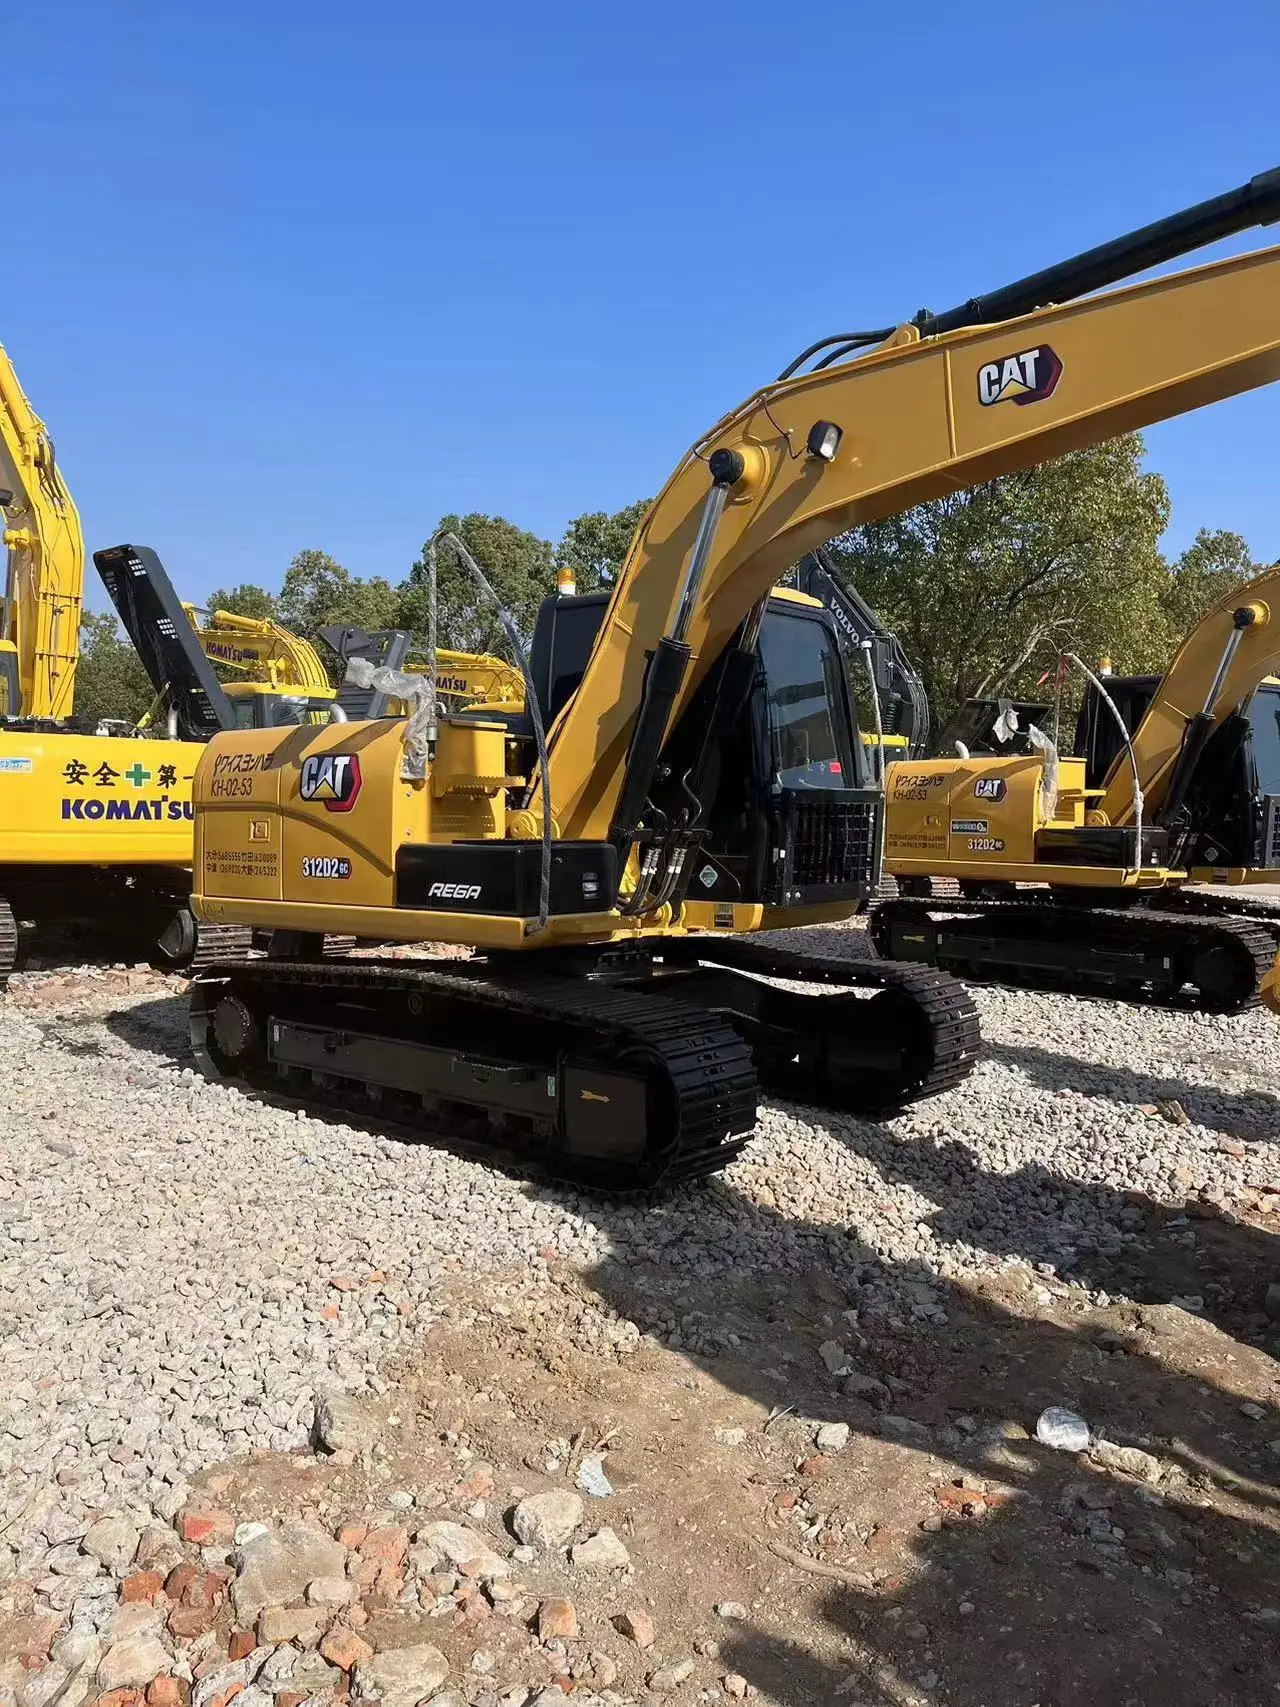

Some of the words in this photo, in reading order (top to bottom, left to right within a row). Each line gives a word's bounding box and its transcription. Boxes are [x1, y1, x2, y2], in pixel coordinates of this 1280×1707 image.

[979, 350, 1040, 404] CAT
[830, 596, 860, 644] VOLVO
[206, 640, 243, 662] KOMATSU
[62, 759, 121, 787] 安全
[301, 756, 351, 799] CAT
[211, 777, 253, 797] KH-02-53
[976, 779, 1001, 798] CAT
[302, 856, 339, 878] 312D2
[428, 882, 482, 900] REGA
